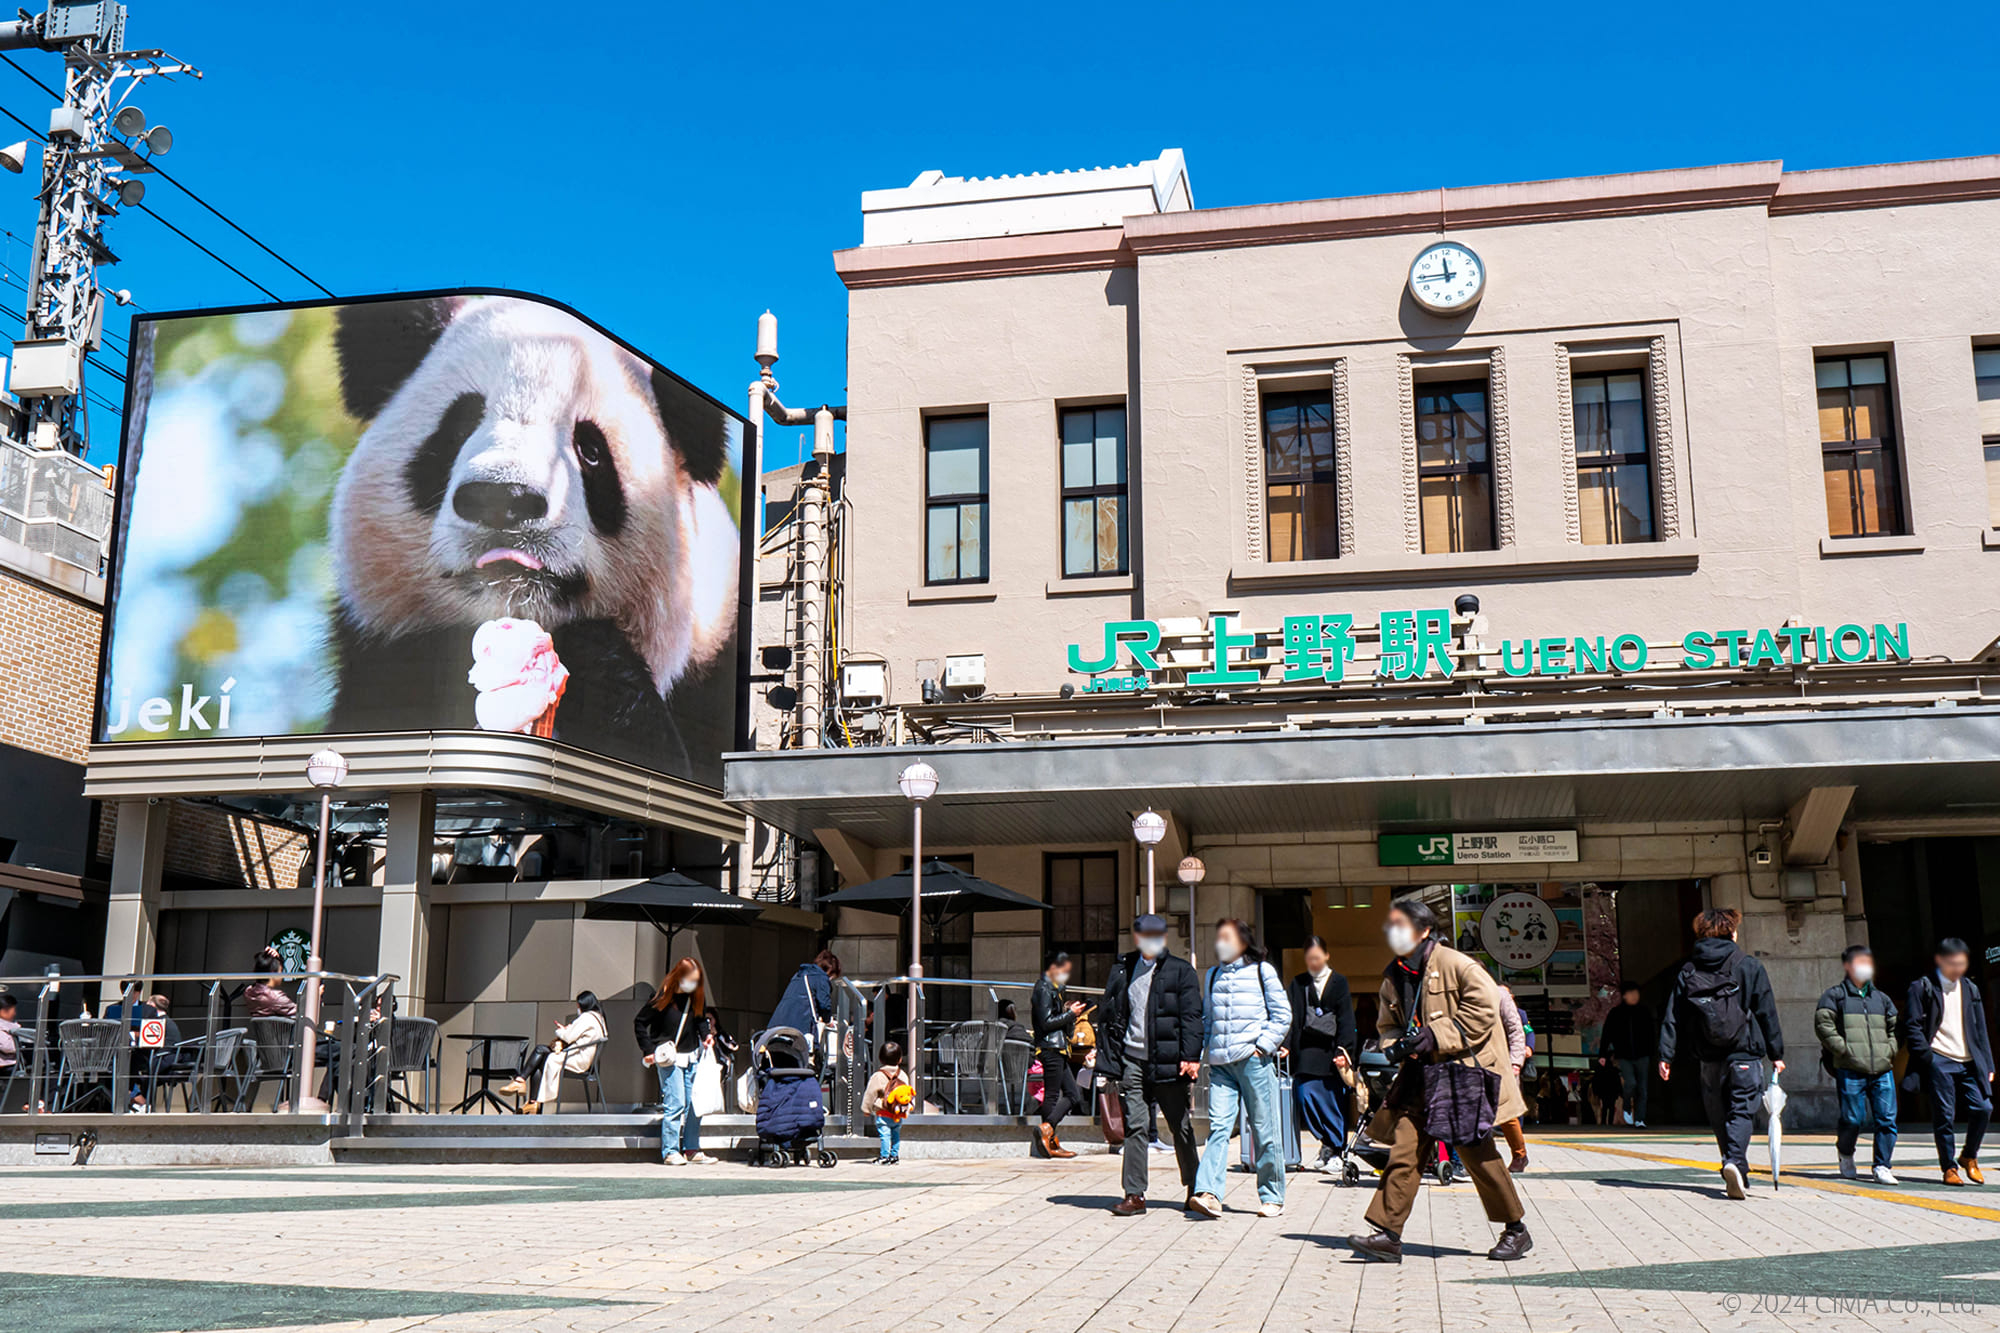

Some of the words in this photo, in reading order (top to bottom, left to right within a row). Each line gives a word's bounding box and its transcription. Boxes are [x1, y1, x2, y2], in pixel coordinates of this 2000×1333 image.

[1066, 619, 1162, 674] JR
[1187, 608, 1455, 686] 上野駅
[1501, 633, 1648, 677] UENO
[1683, 622, 1911, 669] STATION
[1081, 674, 1150, 692] JR東日本
[107, 676, 237, 735] jeki
[1417, 837, 1450, 855] JR
[1457, 836, 1498, 849] 上野駅
[1518, 835, 1555, 844] 広小路口
[1457, 851, 1479, 859] Ueno
[1481, 851, 1511, 859] Station
